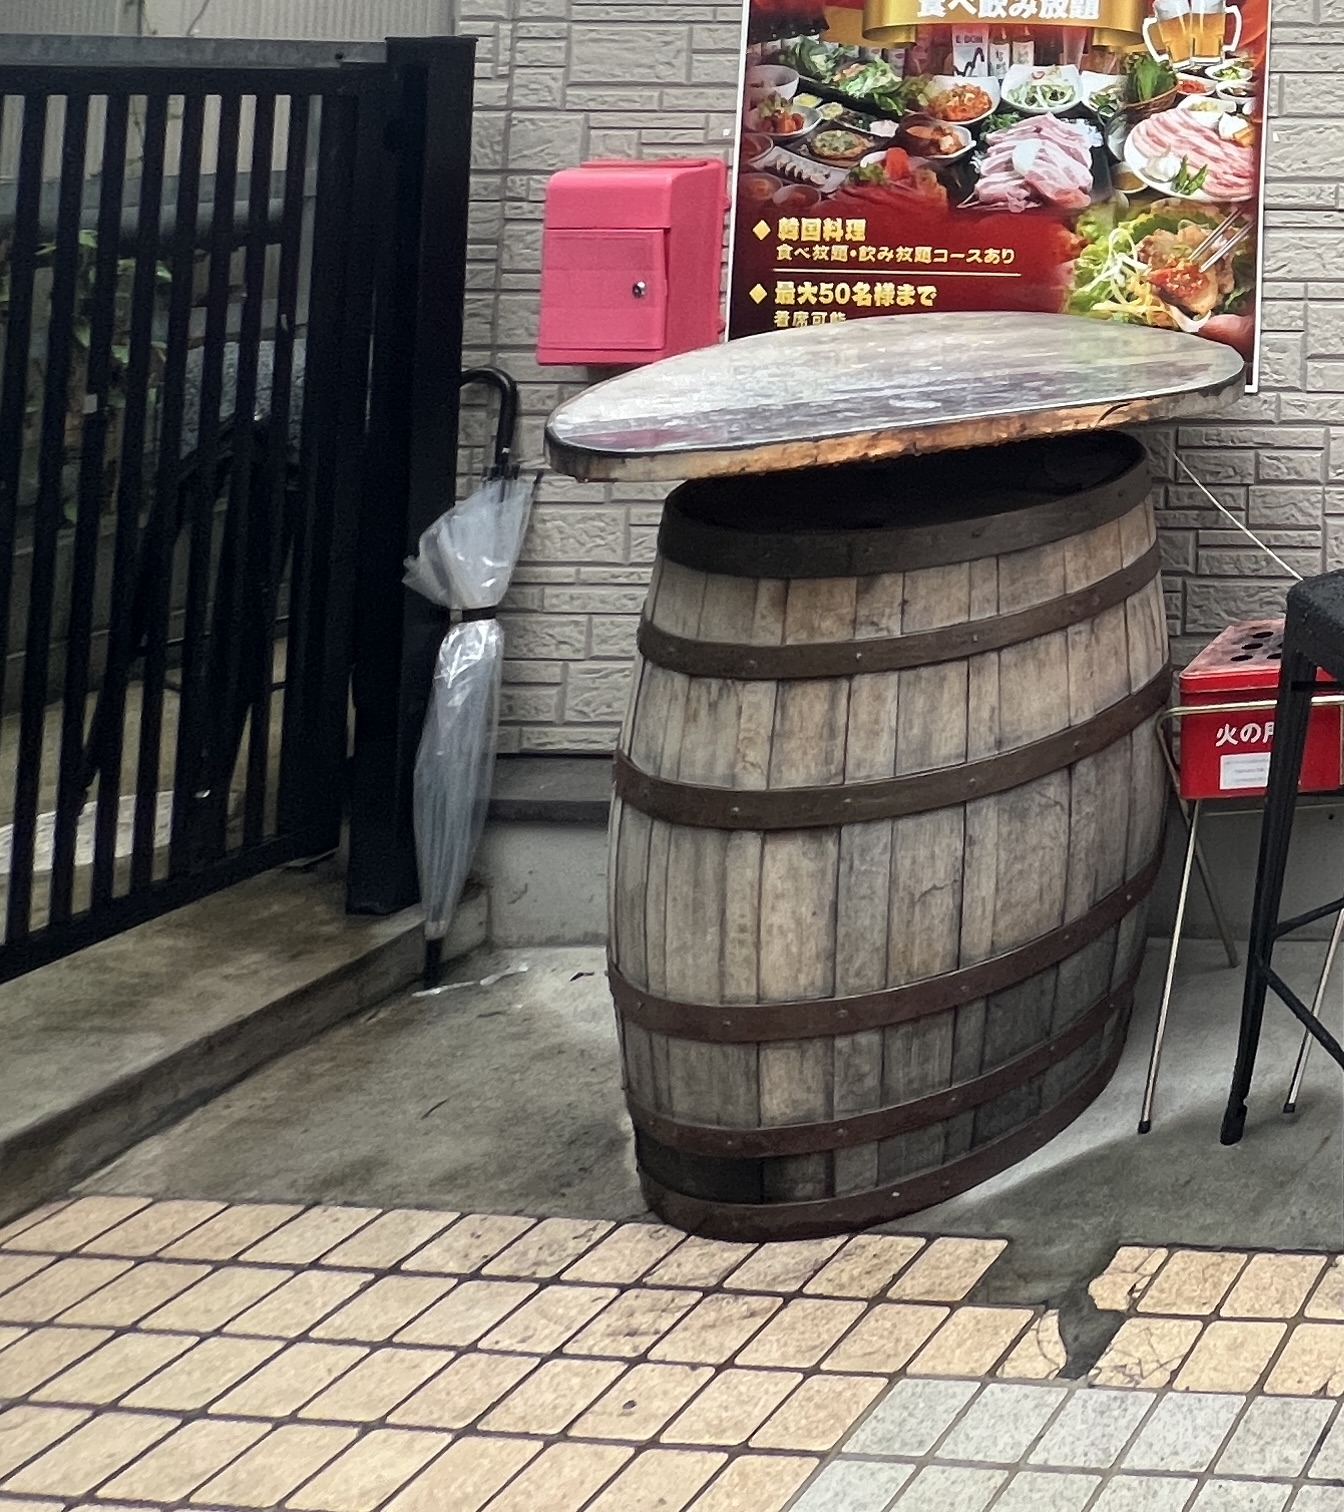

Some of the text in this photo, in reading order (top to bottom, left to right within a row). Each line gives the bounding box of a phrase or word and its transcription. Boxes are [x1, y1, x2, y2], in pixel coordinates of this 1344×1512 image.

[777, 216, 867, 242] 韓国料理
[776, 244, 1015, 265] 食べ放題・飲み放題コースあり
[774, 280, 937, 307] 最大50名様まで
